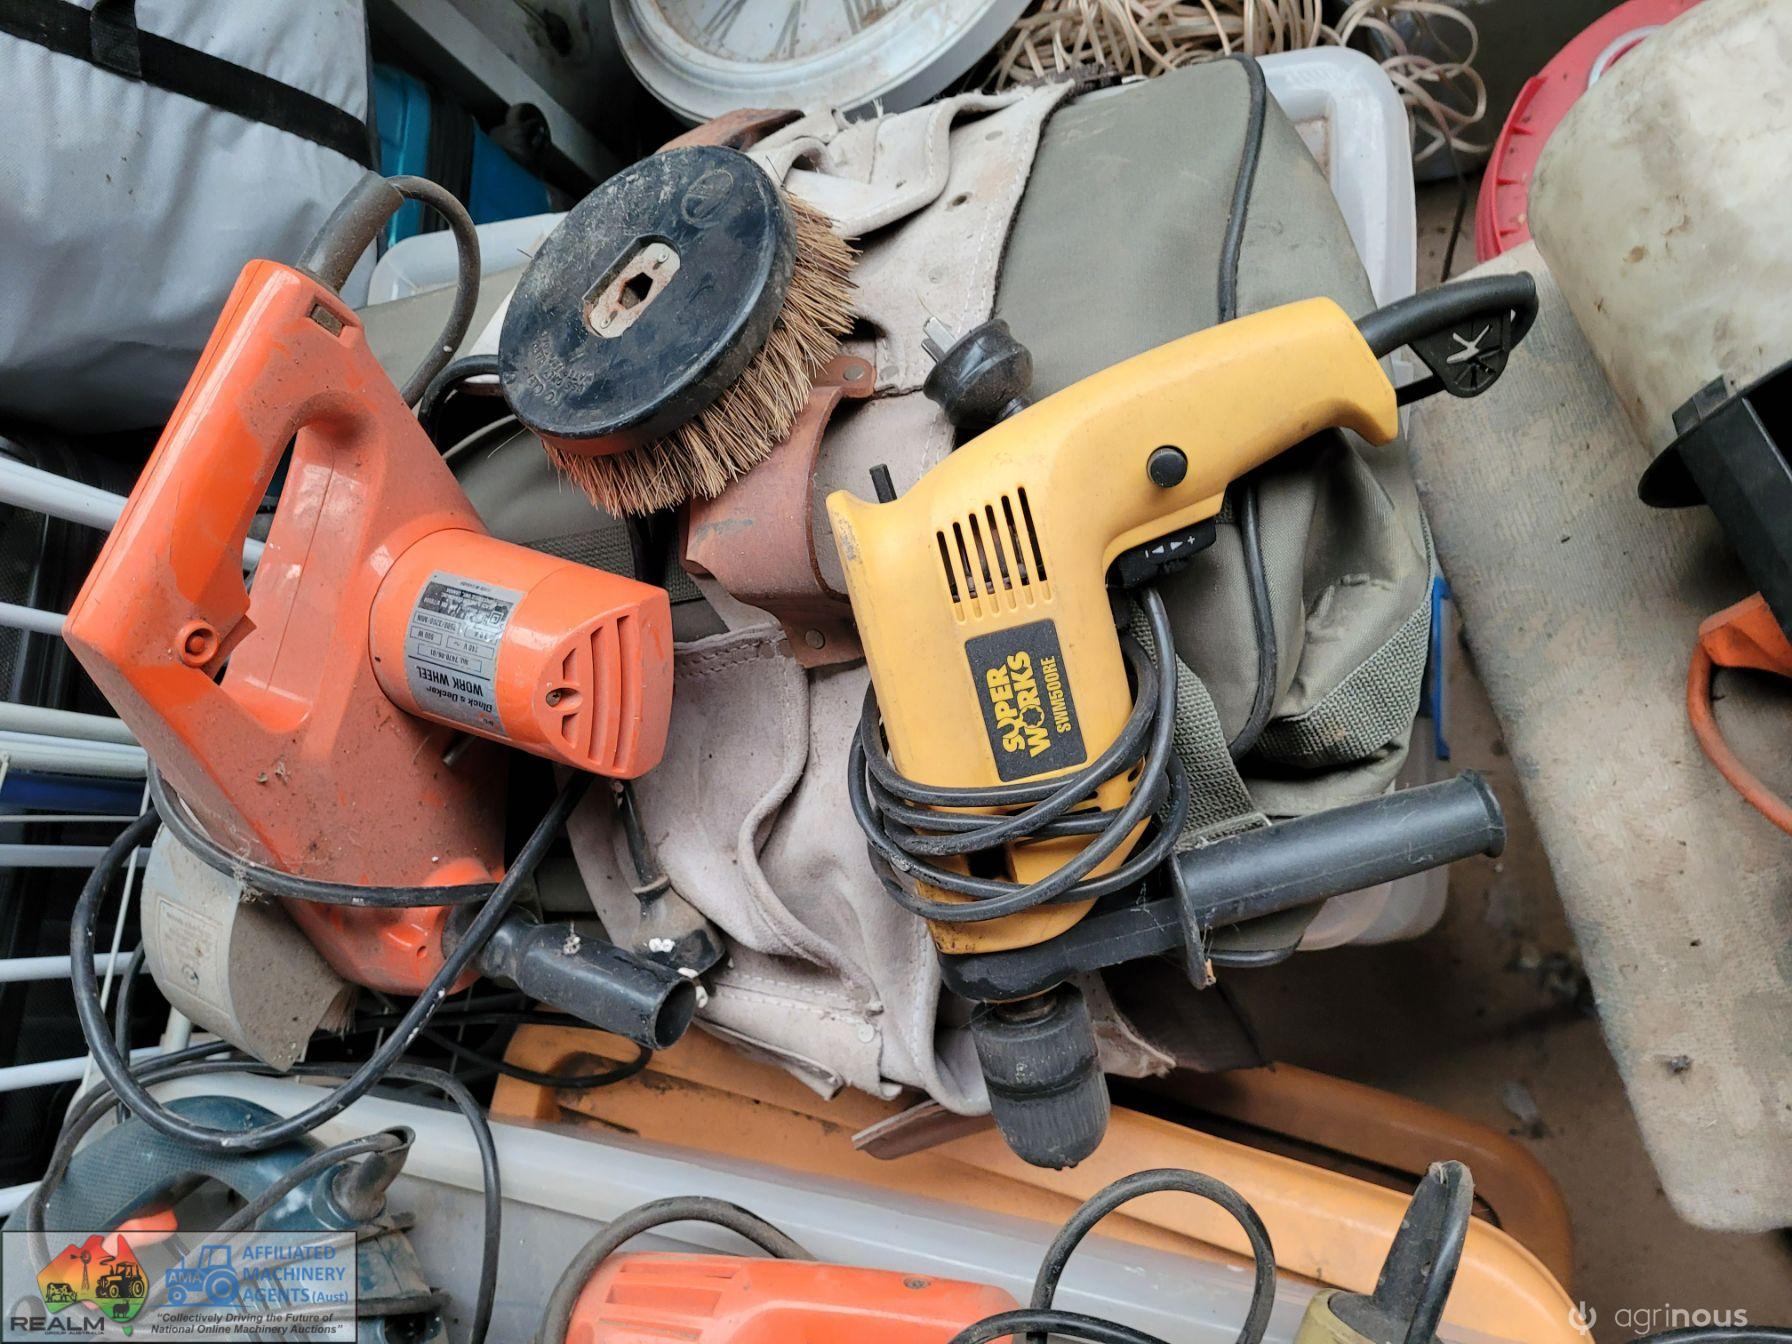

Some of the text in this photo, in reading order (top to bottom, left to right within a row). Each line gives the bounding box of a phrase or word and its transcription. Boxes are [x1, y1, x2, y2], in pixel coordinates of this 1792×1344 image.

[416, 665, 484, 697] WORK WHEEL
[986, 664, 1026, 753] SUPER
[1007, 651, 1051, 758] WORKS
[1041, 655, 1072, 733] SWM500RE
